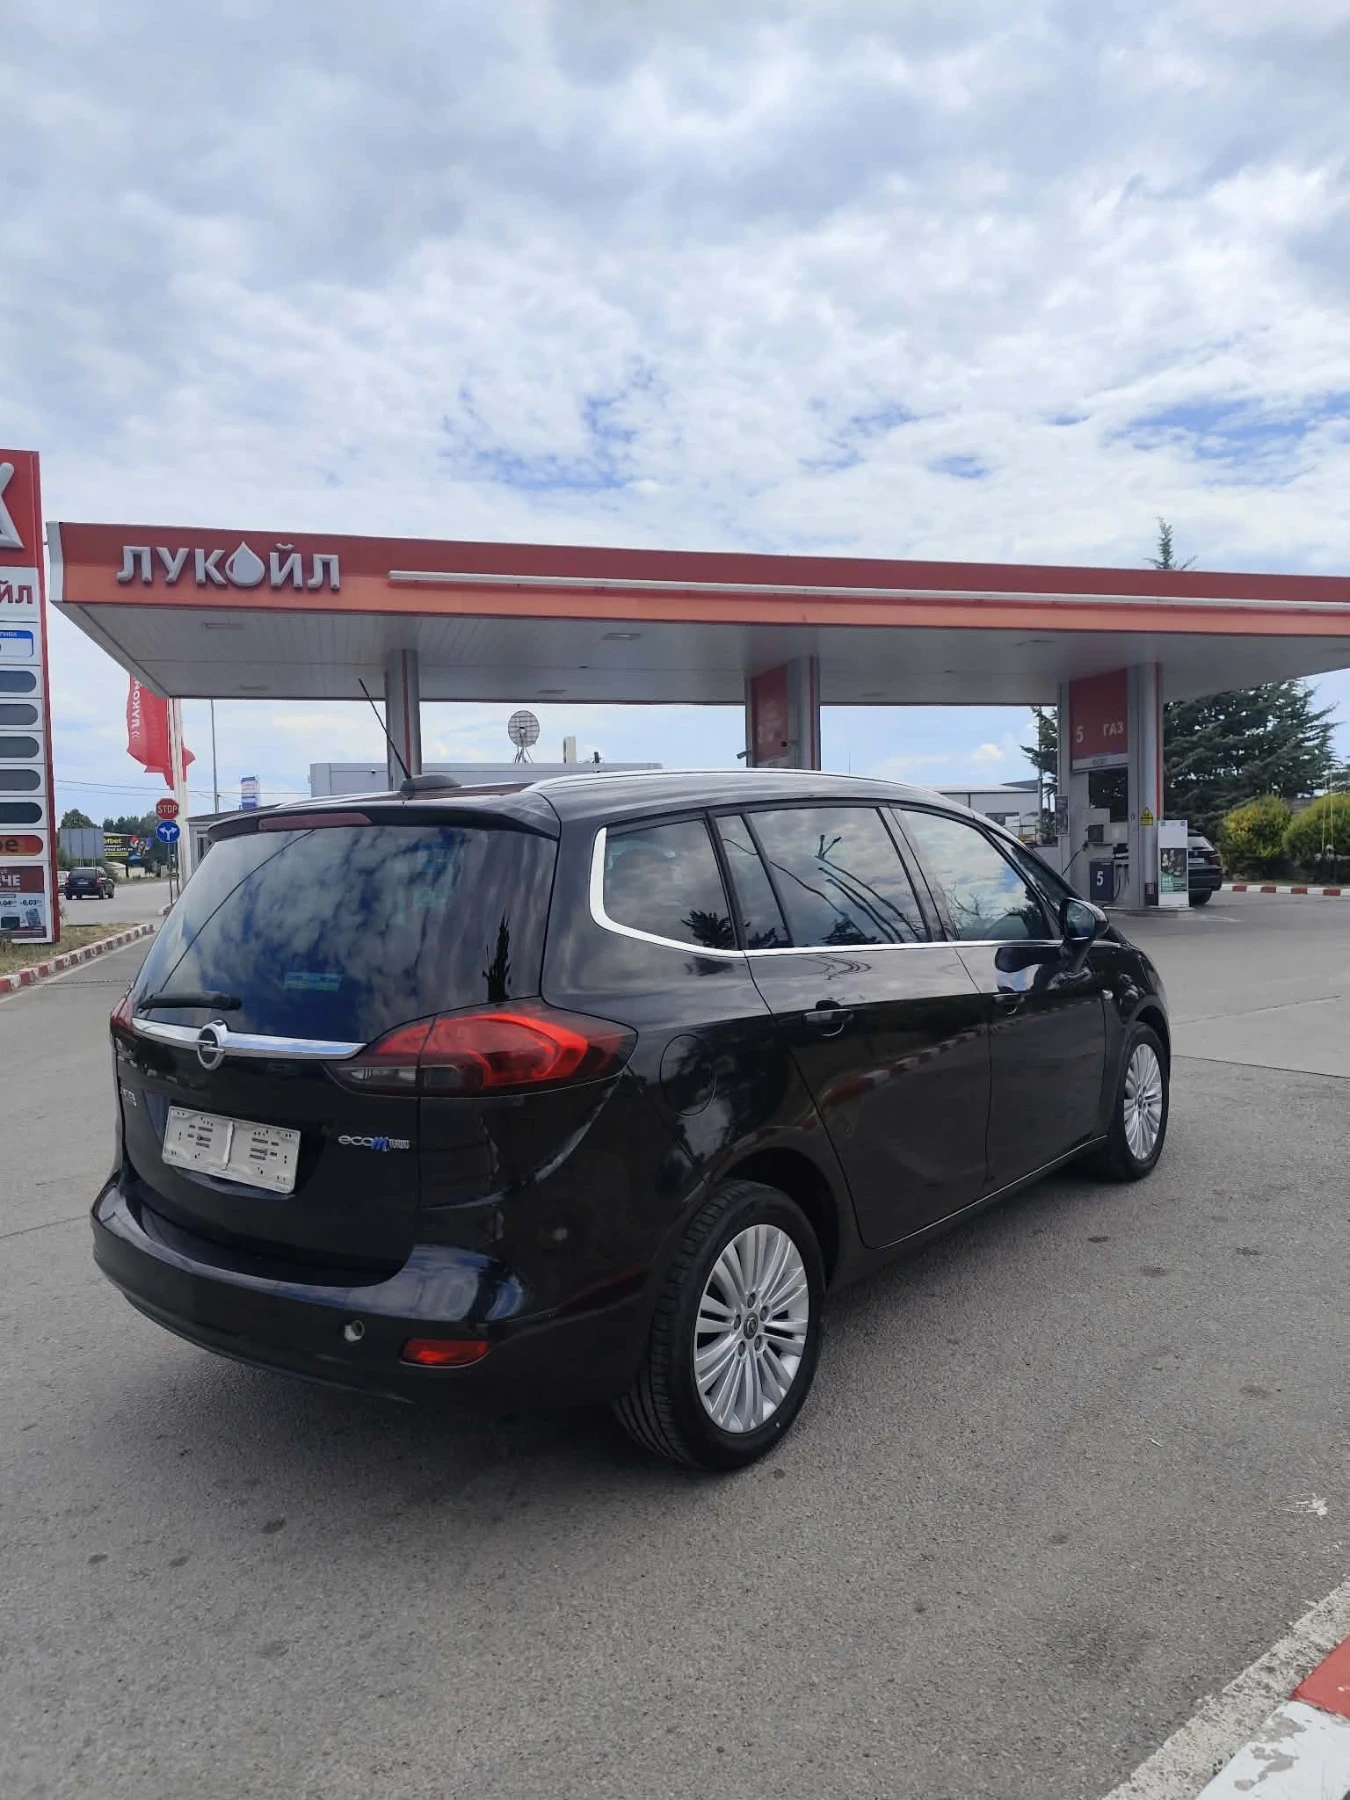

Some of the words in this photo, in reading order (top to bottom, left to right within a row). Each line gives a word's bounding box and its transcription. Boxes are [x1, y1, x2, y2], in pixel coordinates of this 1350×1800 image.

[116, 541, 340, 591] ЛУКОЙЛ
[1076, 725, 1084, 743] 5
[1103, 722, 1124, 736] ГАЗ
[157, 805, 178, 814] STOP
[0, 874, 21, 887] ЧЕ
[1096, 870, 1104, 887] 5
